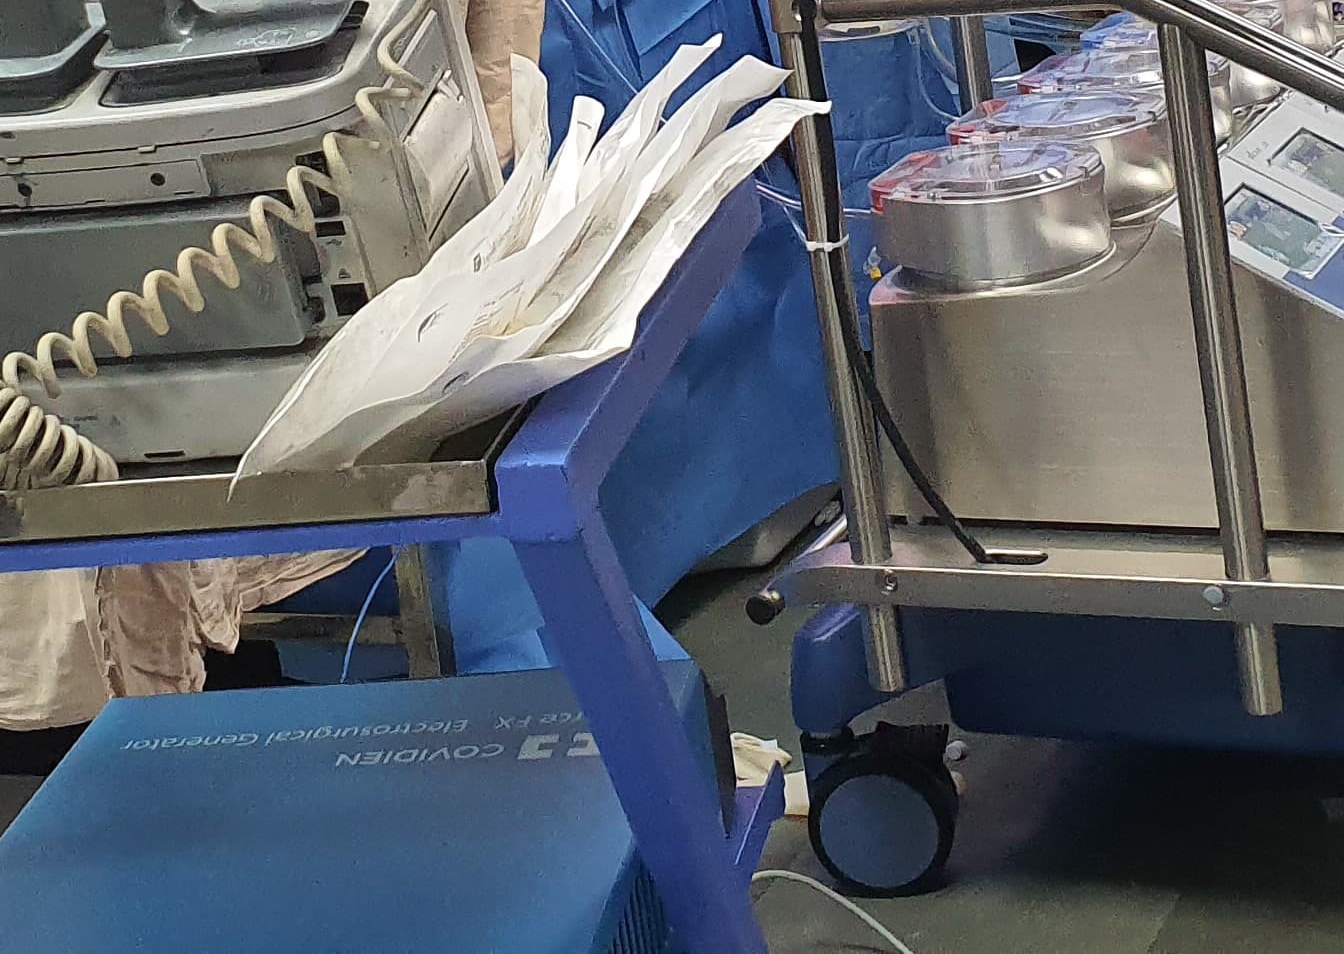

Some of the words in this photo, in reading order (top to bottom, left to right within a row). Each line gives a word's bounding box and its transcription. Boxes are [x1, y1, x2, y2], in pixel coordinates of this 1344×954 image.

[539, 711, 584, 726] rce
[122, 733, 258, 751] Generator
[265, 719, 469, 746] Electrosurgical
[335, 743, 505, 767] COVIDIEN
